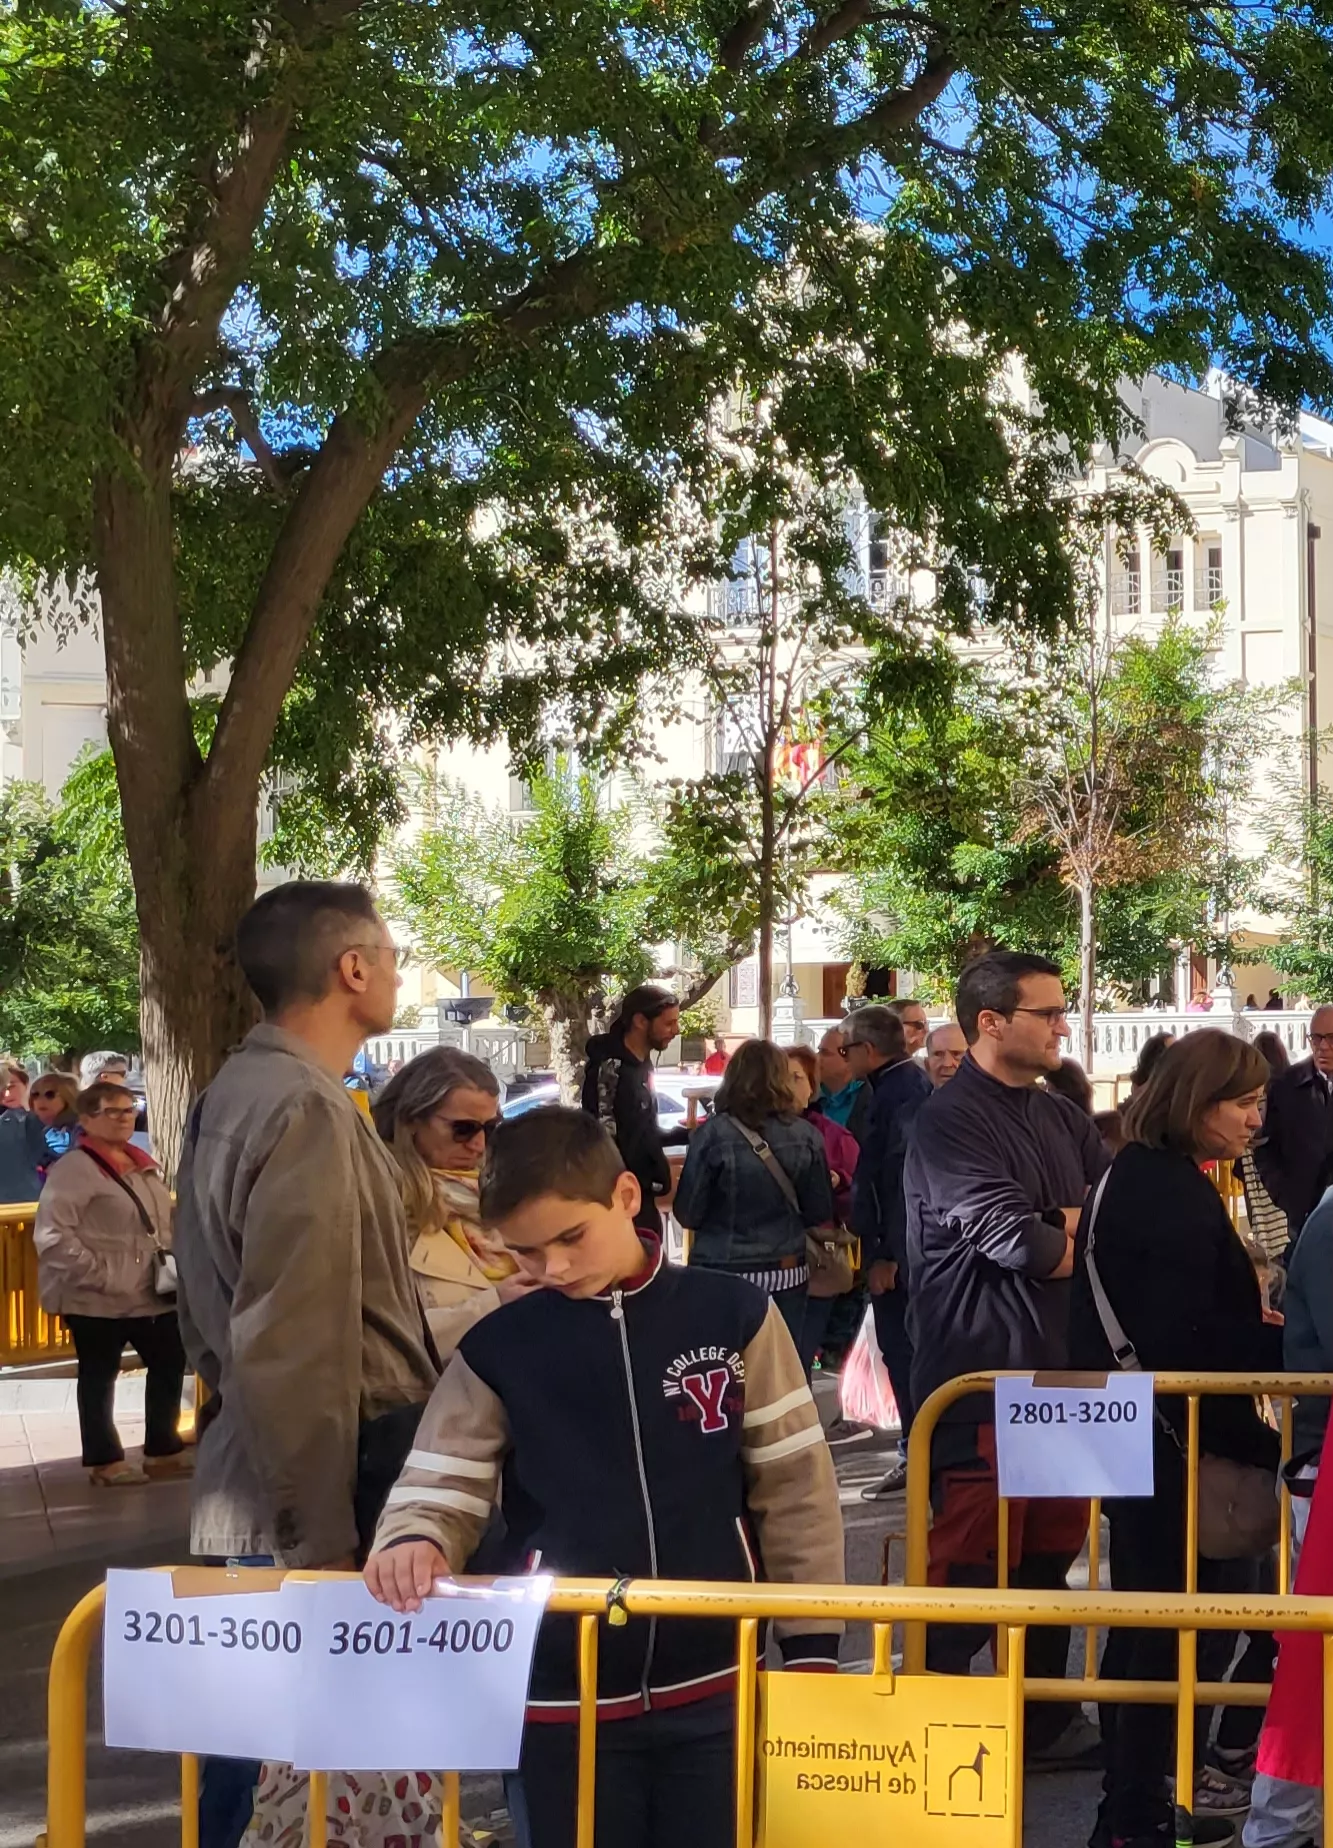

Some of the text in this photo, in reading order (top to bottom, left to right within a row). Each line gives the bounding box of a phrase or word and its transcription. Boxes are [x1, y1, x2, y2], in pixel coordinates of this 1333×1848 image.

[662, 1346, 746, 1397] NY COLLEGE DEPT
[682, 1367, 729, 1434] Y
[1009, 1401, 1138, 1424] 2801-3200
[123, 1610, 302, 1654] 3201-3600
[329, 1618, 514, 1655] 3601-4000
